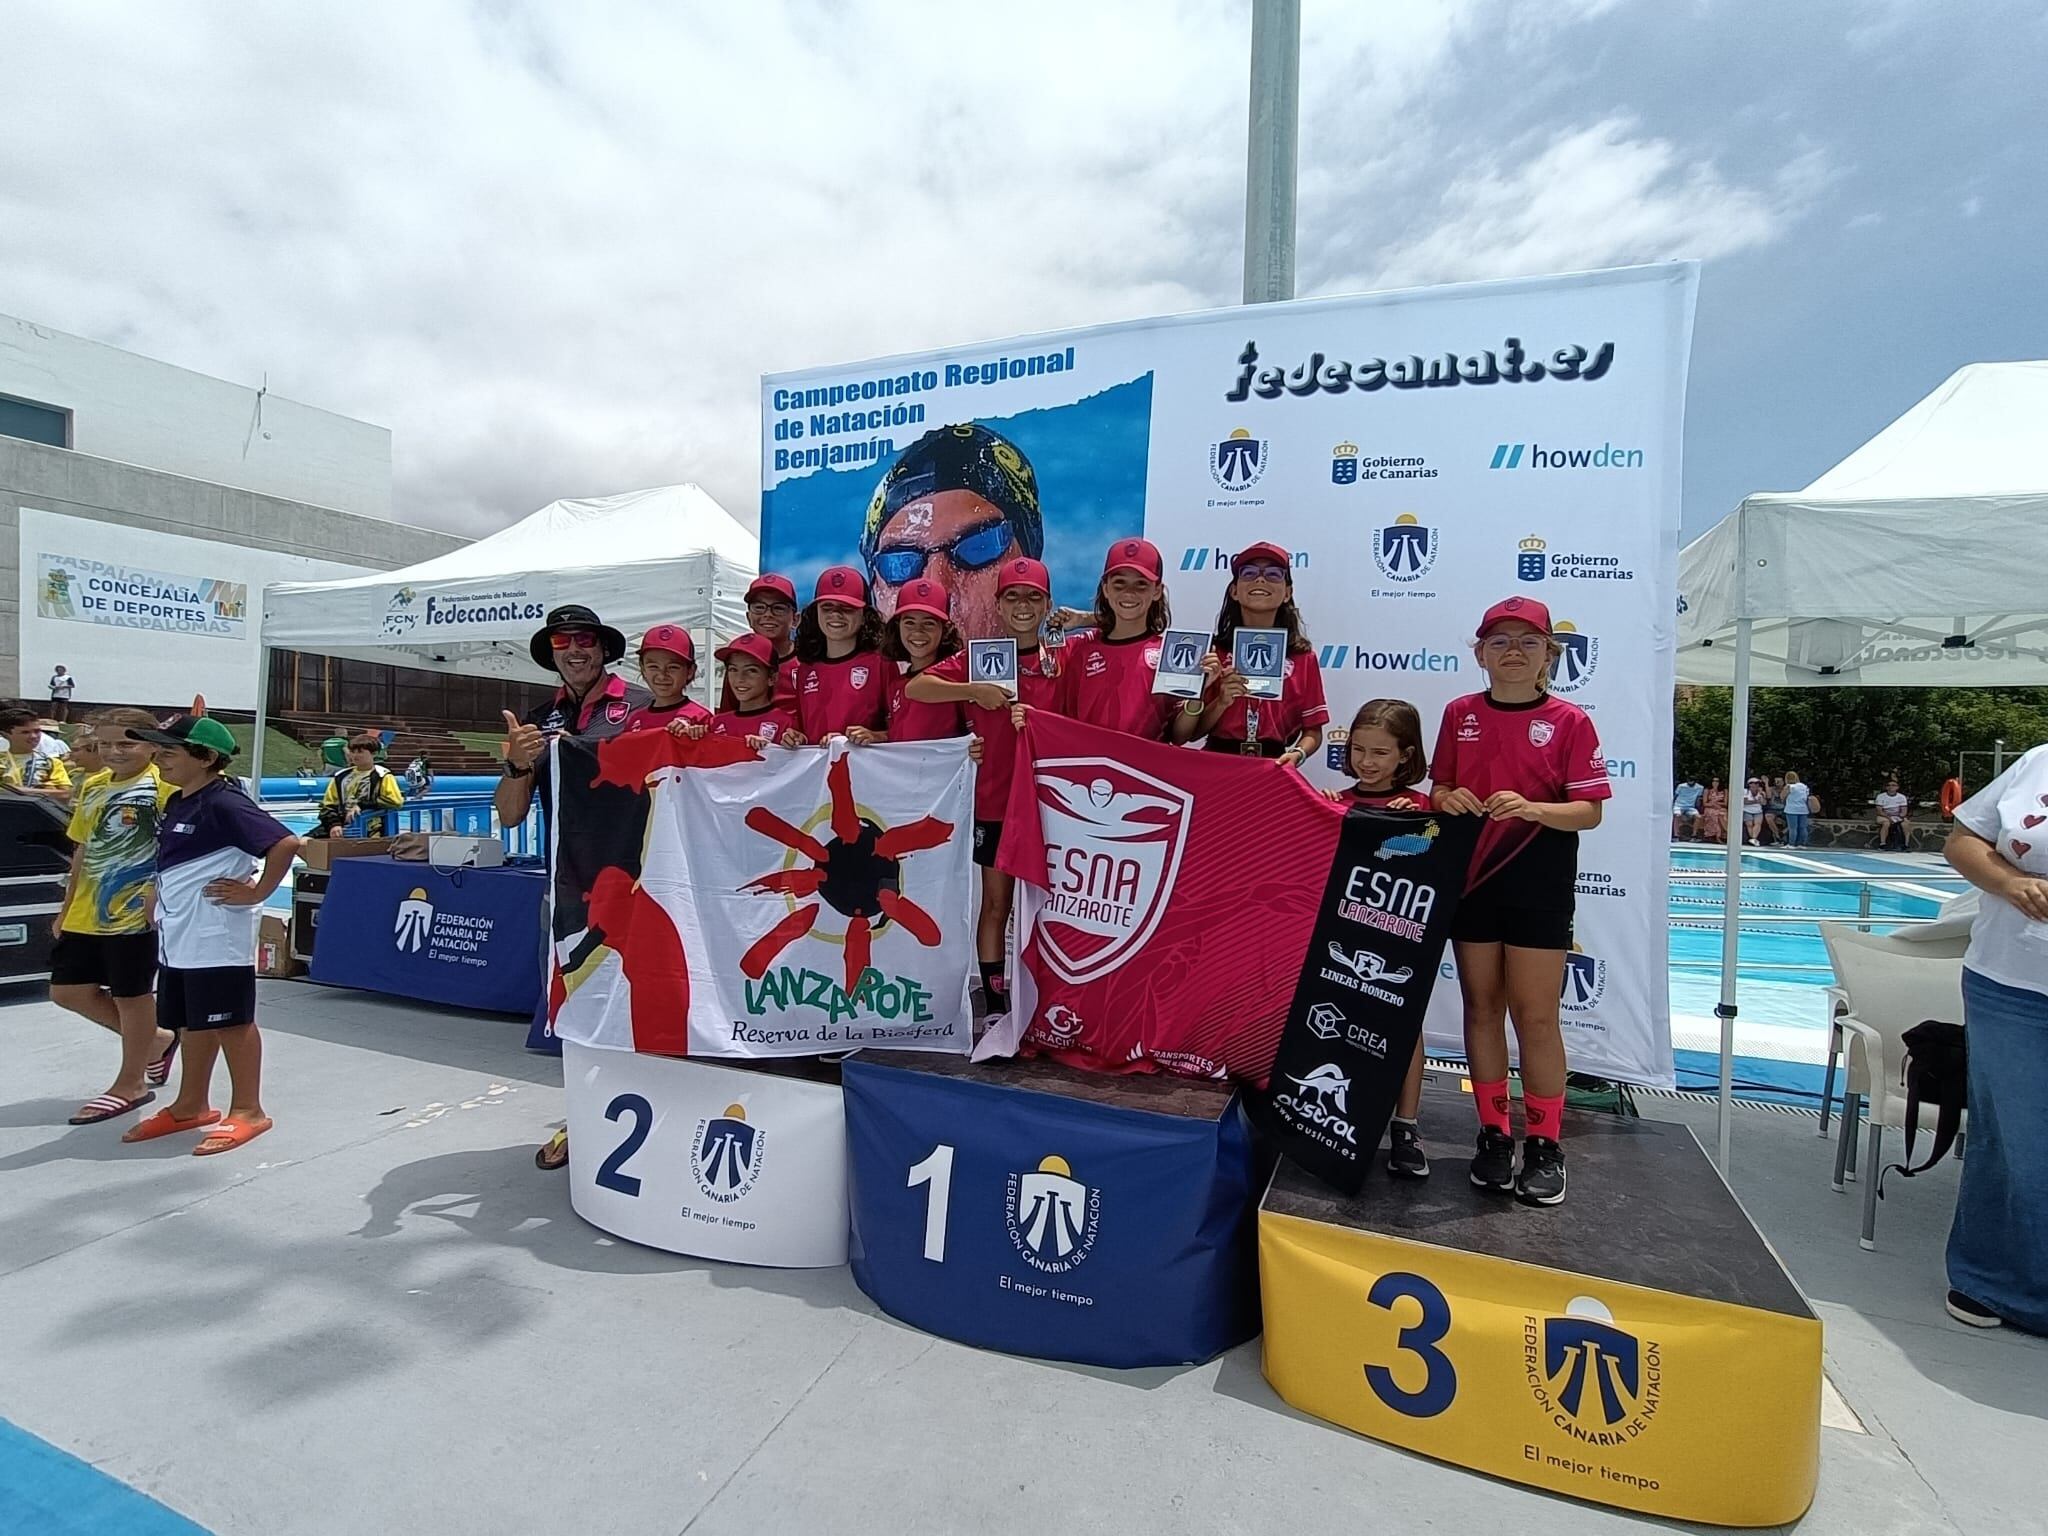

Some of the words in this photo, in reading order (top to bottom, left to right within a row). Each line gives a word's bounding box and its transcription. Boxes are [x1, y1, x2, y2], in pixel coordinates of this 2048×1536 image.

[773, 370, 938, 412] Campeonato
[944, 347, 1075, 388] Regional
[774, 418, 804, 441] de
[810, 401, 925, 437] Natación
[774, 434, 894, 471] Benjamín
[1221, 482, 1252, 493] CANARIA
[1259, 440, 1269, 475] NATACIÓN
[1362, 456, 1425, 468] Gobierno
[1531, 442, 1644, 469] howden
[1361, 467, 1377, 480] de
[1379, 466, 1438, 479] Canarias
[1217, 500, 1237, 509] mejor
[1239, 498, 1265, 508] tiempo
[1372, 528, 1387, 575] FEDERACIÓN
[1385, 570, 1421, 583] CANARIA
[1420, 564, 1432, 575] DE
[1428, 527, 1439, 566] NATACIÓN
[1551, 553, 1619, 566] Gobierno
[1550, 566, 1567, 578] de
[1570, 567, 1634, 580] Canarias
[88, 578, 200, 604] CONCEJALÍA
[1382, 590, 1405, 599] mejor
[1407, 590, 1436, 599] tiempo
[82, 595, 107, 610] DE
[113, 600, 206, 622] DEPORTES
[385, 615, 414, 624] FCN
[426, 597, 544, 625] fedecanat.es
[1355, 645, 1459, 672] howden
[1547, 683, 1580, 693] ANARIA
[1579, 675, 1591, 687] DE
[1045, 843, 1141, 905] ESNA
[1344, 865, 1436, 923] ESNA
[1573, 884, 1627, 897] anarias
[435, 912, 494, 929] FEDERACIÓN
[1045, 892, 1133, 928] ANZAROTE
[1337, 899, 1427, 943] LANZAROTE
[431, 937, 478, 952] NATACIÓN
[433, 925, 474, 940] CANARIA
[475, 931, 489, 942] DE
[428, 950, 437, 959] El
[438, 952, 459, 964] mejor
[461, 955, 488, 967] tiempo
[745, 966, 934, 1024] LANZAROTE
[1319, 967, 1360, 991] LINEAS
[1360, 983, 1405, 1008] ROMERO
[1561, 1003, 1589, 1013] NARIA
[1587, 998, 1600, 1009] DE
[731, 1021, 810, 1043] Reserva
[816, 1025, 838, 1041] de
[845, 1026, 864, 1040] la
[1347, 1024, 1387, 1054] CREA
[1575, 1020, 1607, 1032] tiempo
[1272, 1100, 1357, 1161] www.austral.es
[595, 1093, 653, 1198] 2
[689, 1118, 707, 1185] FEDERACIÓN
[700, 1184, 740, 1204] CANARIA
[740, 1183, 752, 1196] DE
[748, 1130, 767, 1184] NATACIÓN
[907, 1144, 954, 1263] 1
[681, 1207, 691, 1217] El
[693, 1211, 719, 1225] mejor
[722, 1216, 756, 1231] tiempo
[1005, 1172, 1024, 1250] FEDERACIÓN
[1022, 1250, 1072, 1274] CANARIA
[1071, 1249, 1087, 1266] DE
[1083, 1188, 1101, 1251] NATACIÓN
[999, 1276, 1011, 1289] El
[1014, 1282, 1047, 1297] mejor
[1051, 1288, 1094, 1306] tiempo
[1364, 1271, 1458, 1419] 3
[1523, 1315, 1554, 1414] FEDERACIÓN
[1553, 1413, 1627, 1447] CANARIA
[1625, 1420, 1648, 1439] DE
[1640, 1341, 1661, 1420] NATACIÓN
[1524, 1444, 1540, 1461] El
[1545, 1453, 1594, 1476] mejor
[1599, 1466, 1661, 1491] tiempo
